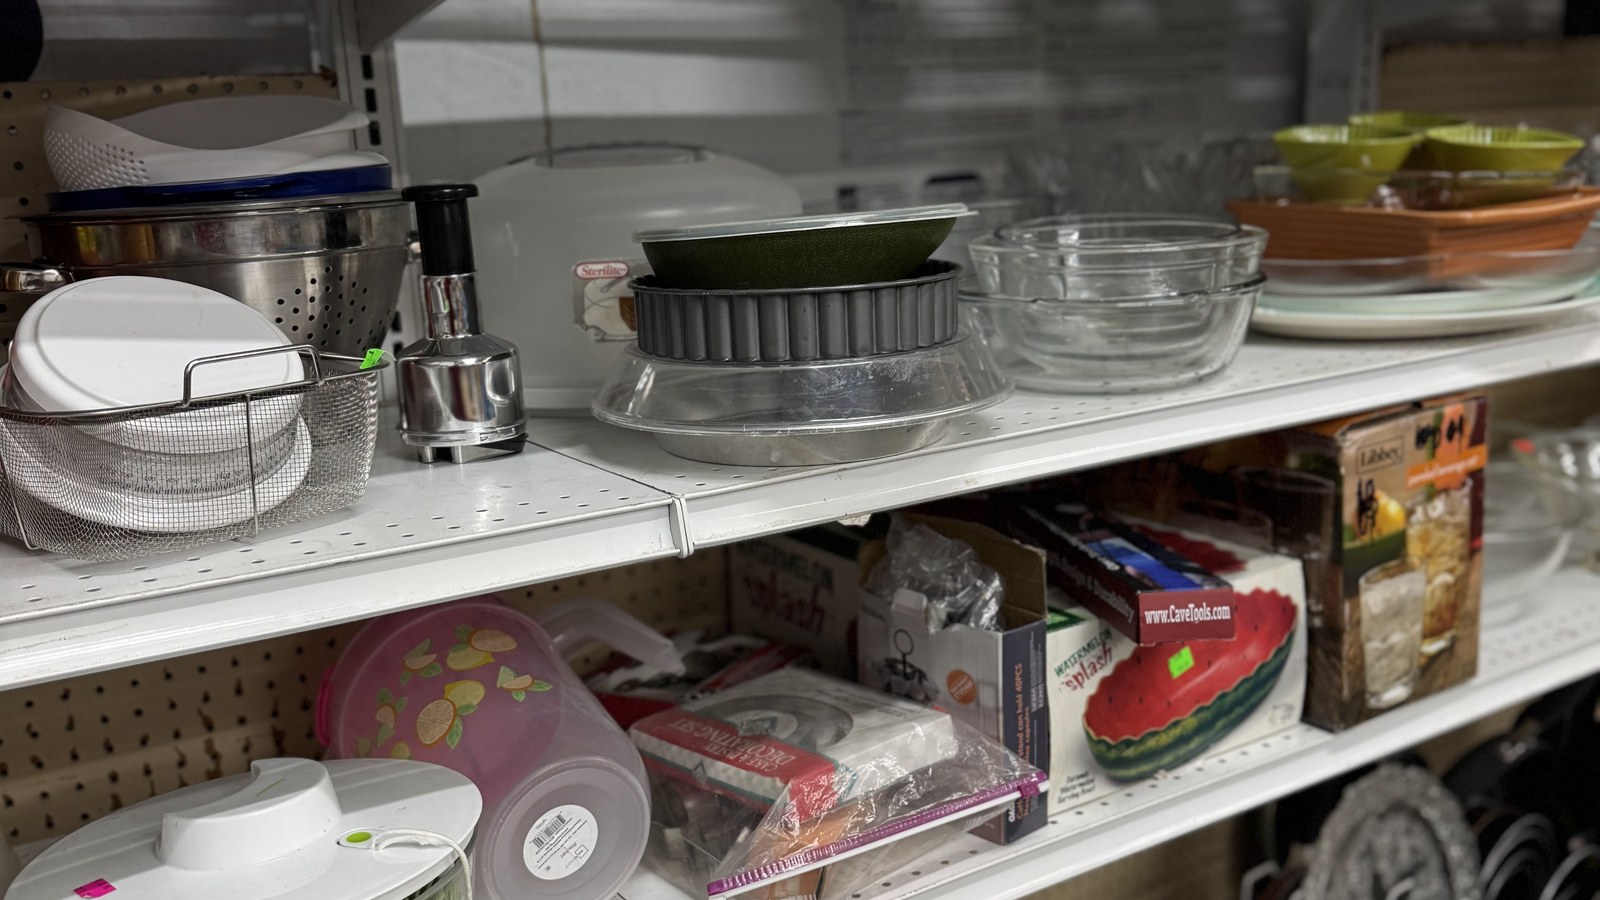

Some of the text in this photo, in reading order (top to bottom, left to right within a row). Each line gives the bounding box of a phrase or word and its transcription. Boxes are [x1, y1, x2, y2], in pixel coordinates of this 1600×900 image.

[581, 264, 620, 277] Sterilite
[1361, 447, 1399, 467] Libbey
[1144, 602, 1231, 624] www.CaveTools.com
[1054, 627, 1112, 678] WATERMELON
[1064, 641, 1113, 692] splash
[1016, 693, 1024, 714] hold
[668, 718, 797, 765] DECORATING SET
[705, 743, 740, 760] PASTRY
[750, 758, 779, 772] CAKE
